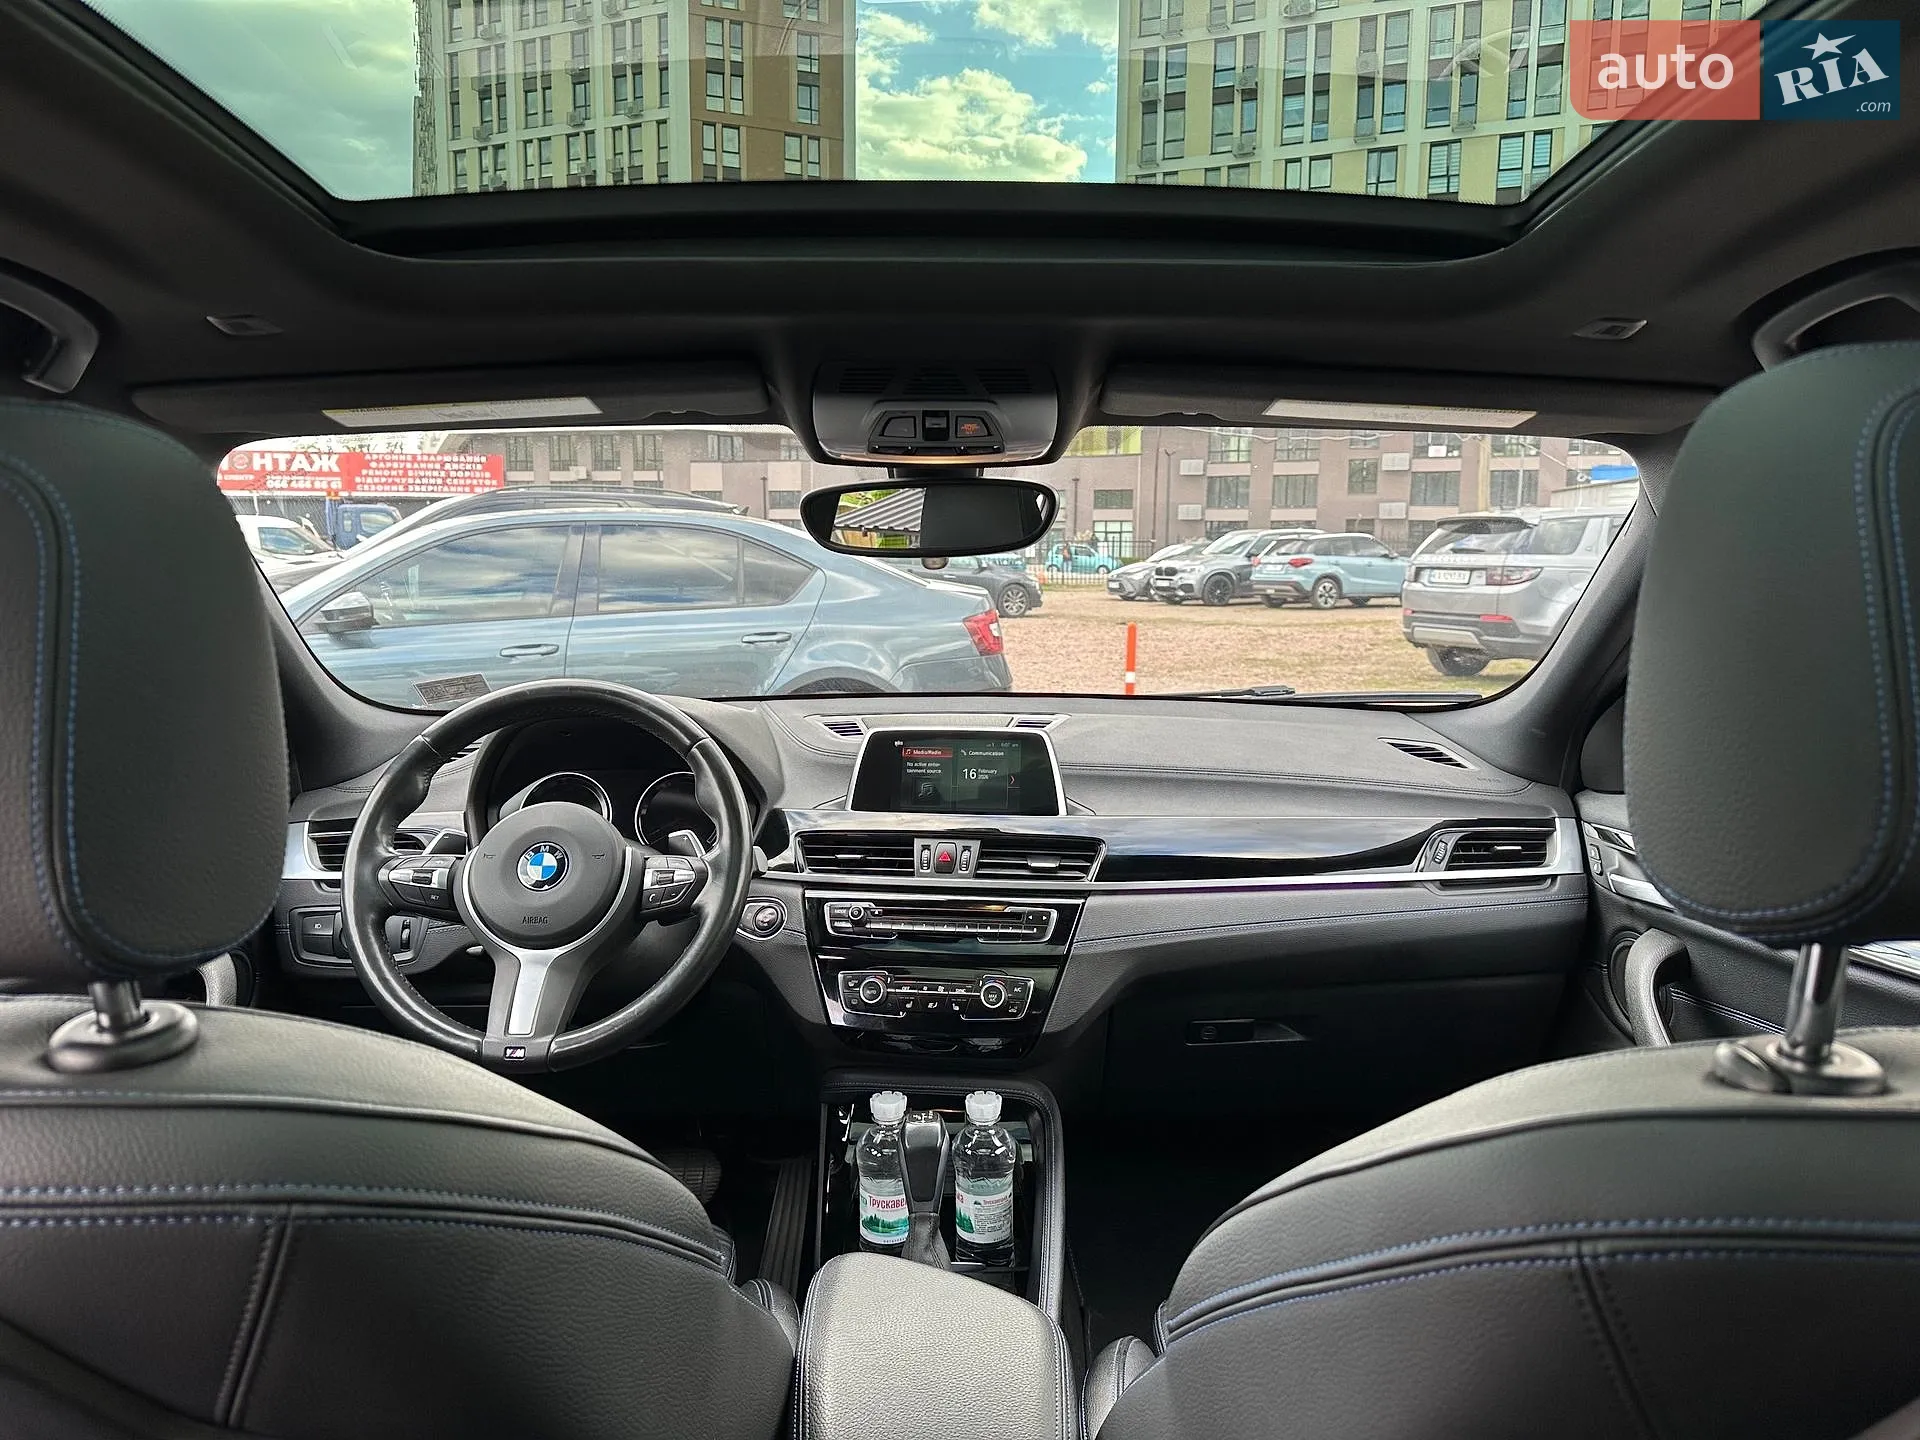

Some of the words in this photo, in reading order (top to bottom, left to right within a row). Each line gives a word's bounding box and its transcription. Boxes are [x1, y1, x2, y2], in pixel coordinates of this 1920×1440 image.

[444, 462, 483, 471] ДИСКІВ
[361, 469, 404, 477] РЕМОНТ
[963, 768, 977, 779] 16
[523, 845, 563, 861] BMW
[522, 916, 548, 924] AIRBAG
[868, 1195, 907, 1209] Трускаве
